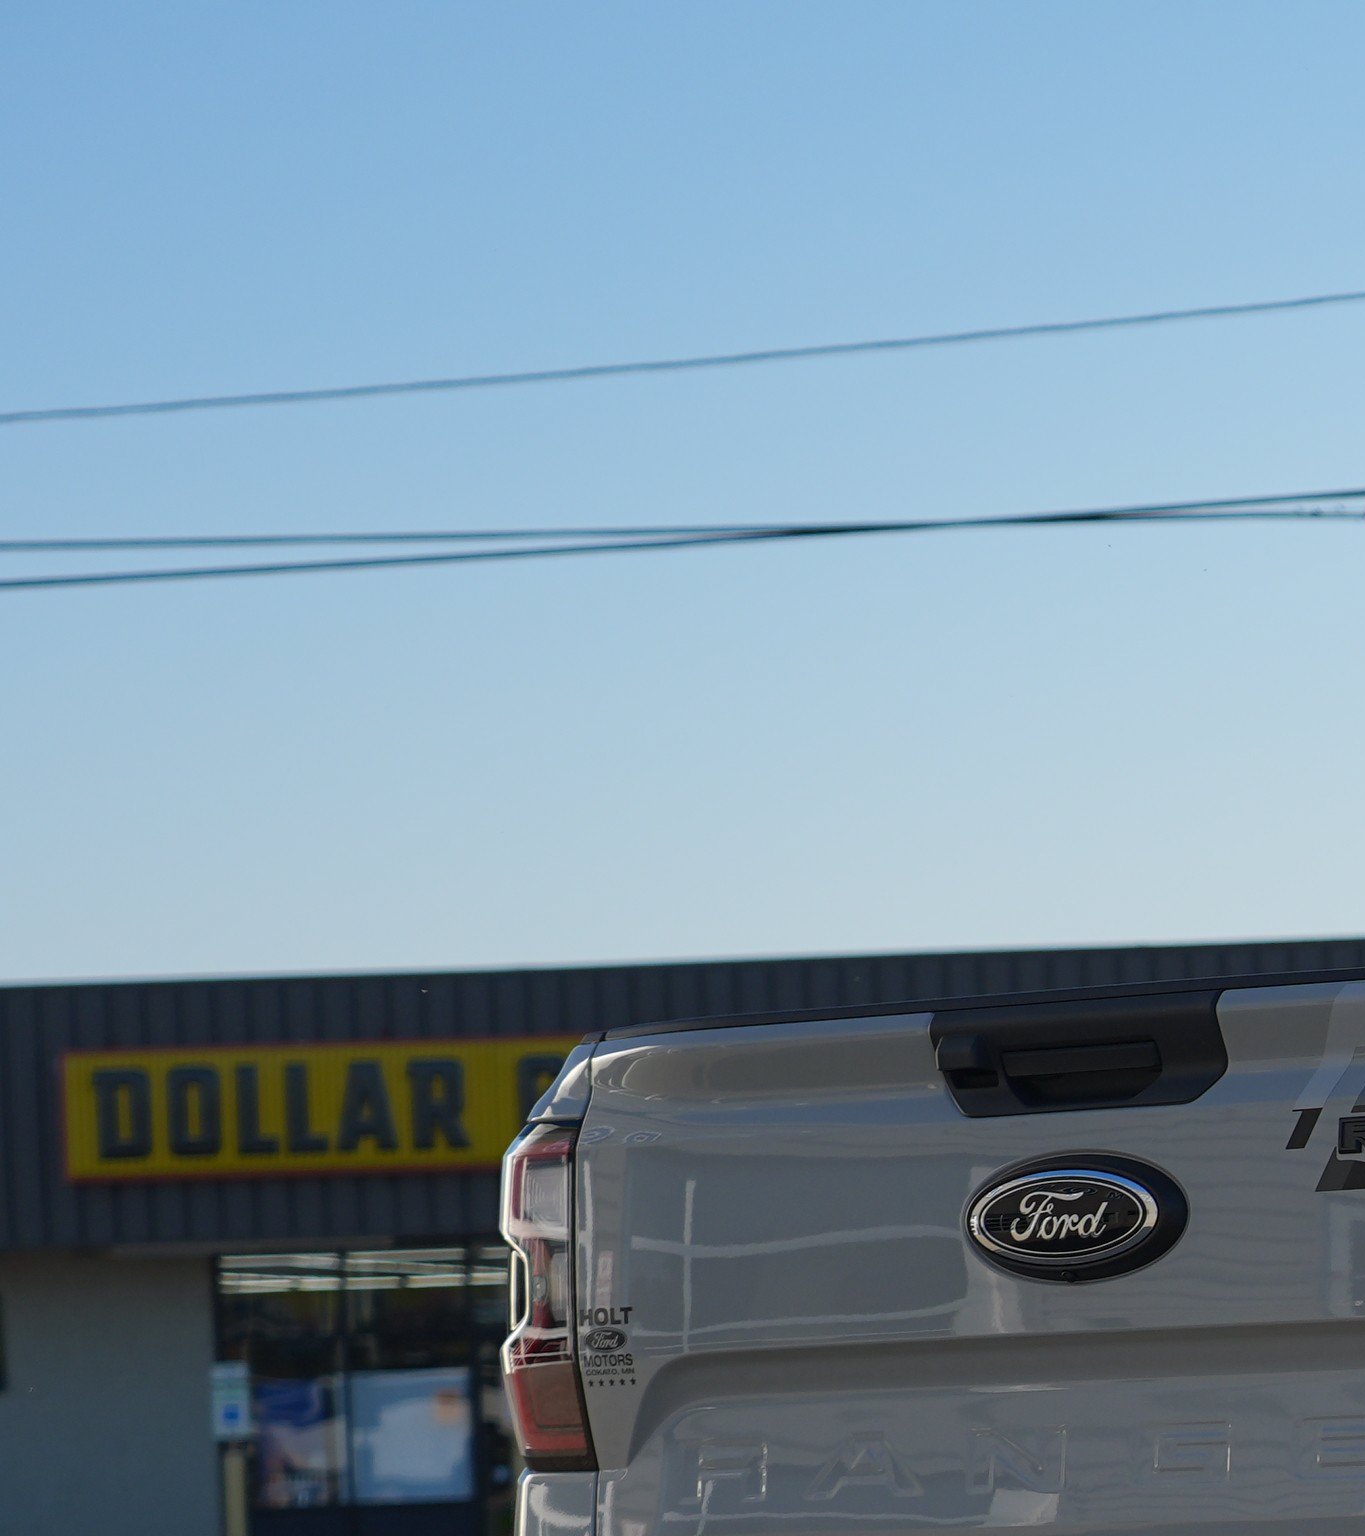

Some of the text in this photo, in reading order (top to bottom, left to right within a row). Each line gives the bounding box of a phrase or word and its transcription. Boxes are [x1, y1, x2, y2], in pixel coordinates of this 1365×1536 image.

[92, 1056, 470, 1160] DOLLAR
[1010, 1189, 1107, 1242] Ford
[579, 1307, 633, 1327] HOLT
[583, 1353, 634, 1368] MOTORS
